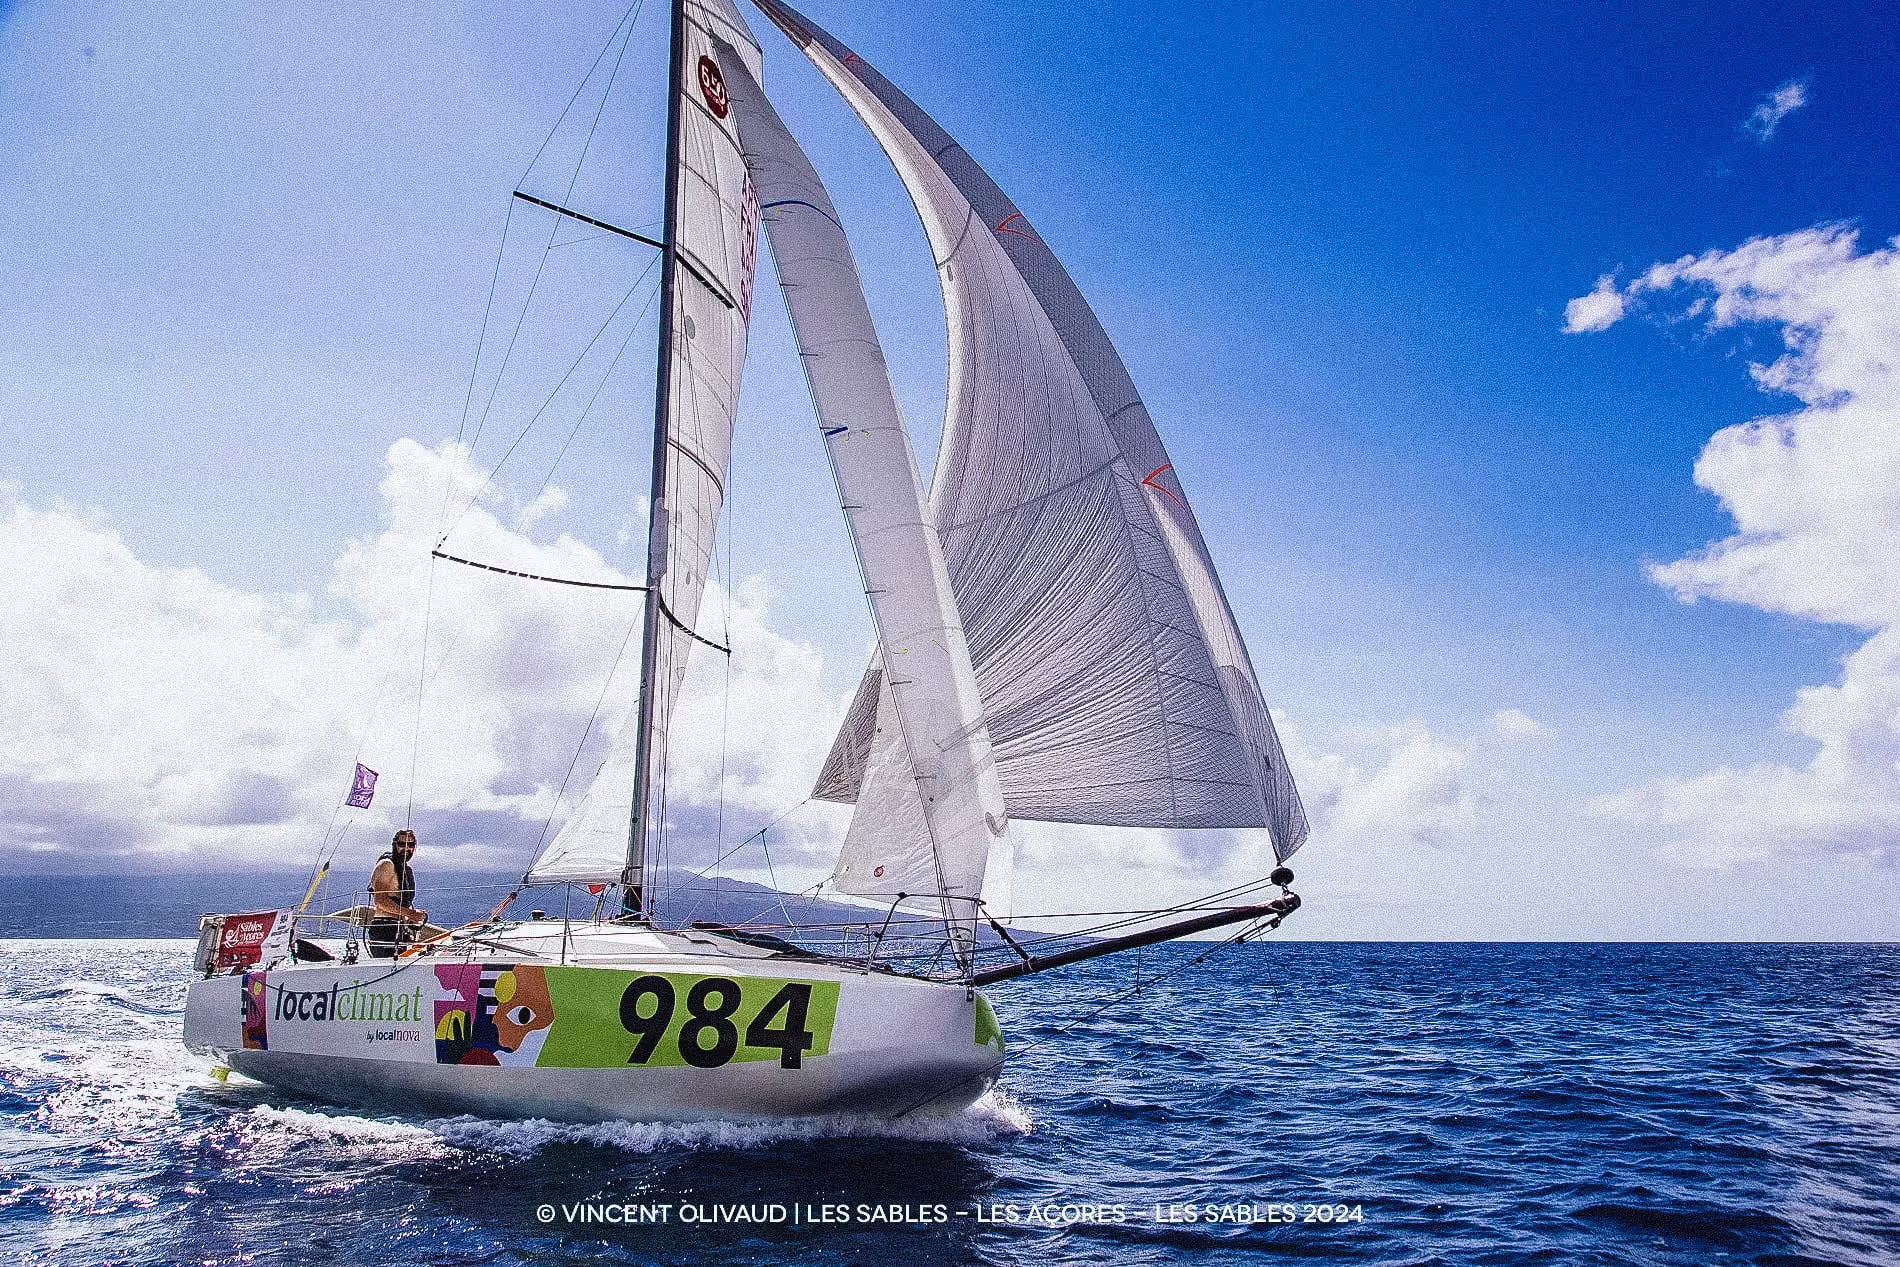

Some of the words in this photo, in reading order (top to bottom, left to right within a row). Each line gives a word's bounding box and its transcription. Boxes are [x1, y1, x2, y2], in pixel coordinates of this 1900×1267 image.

[366, 1031, 374, 1043] by
[375, 1029, 421, 1042] localnova
[619, 975, 814, 1069] 984
